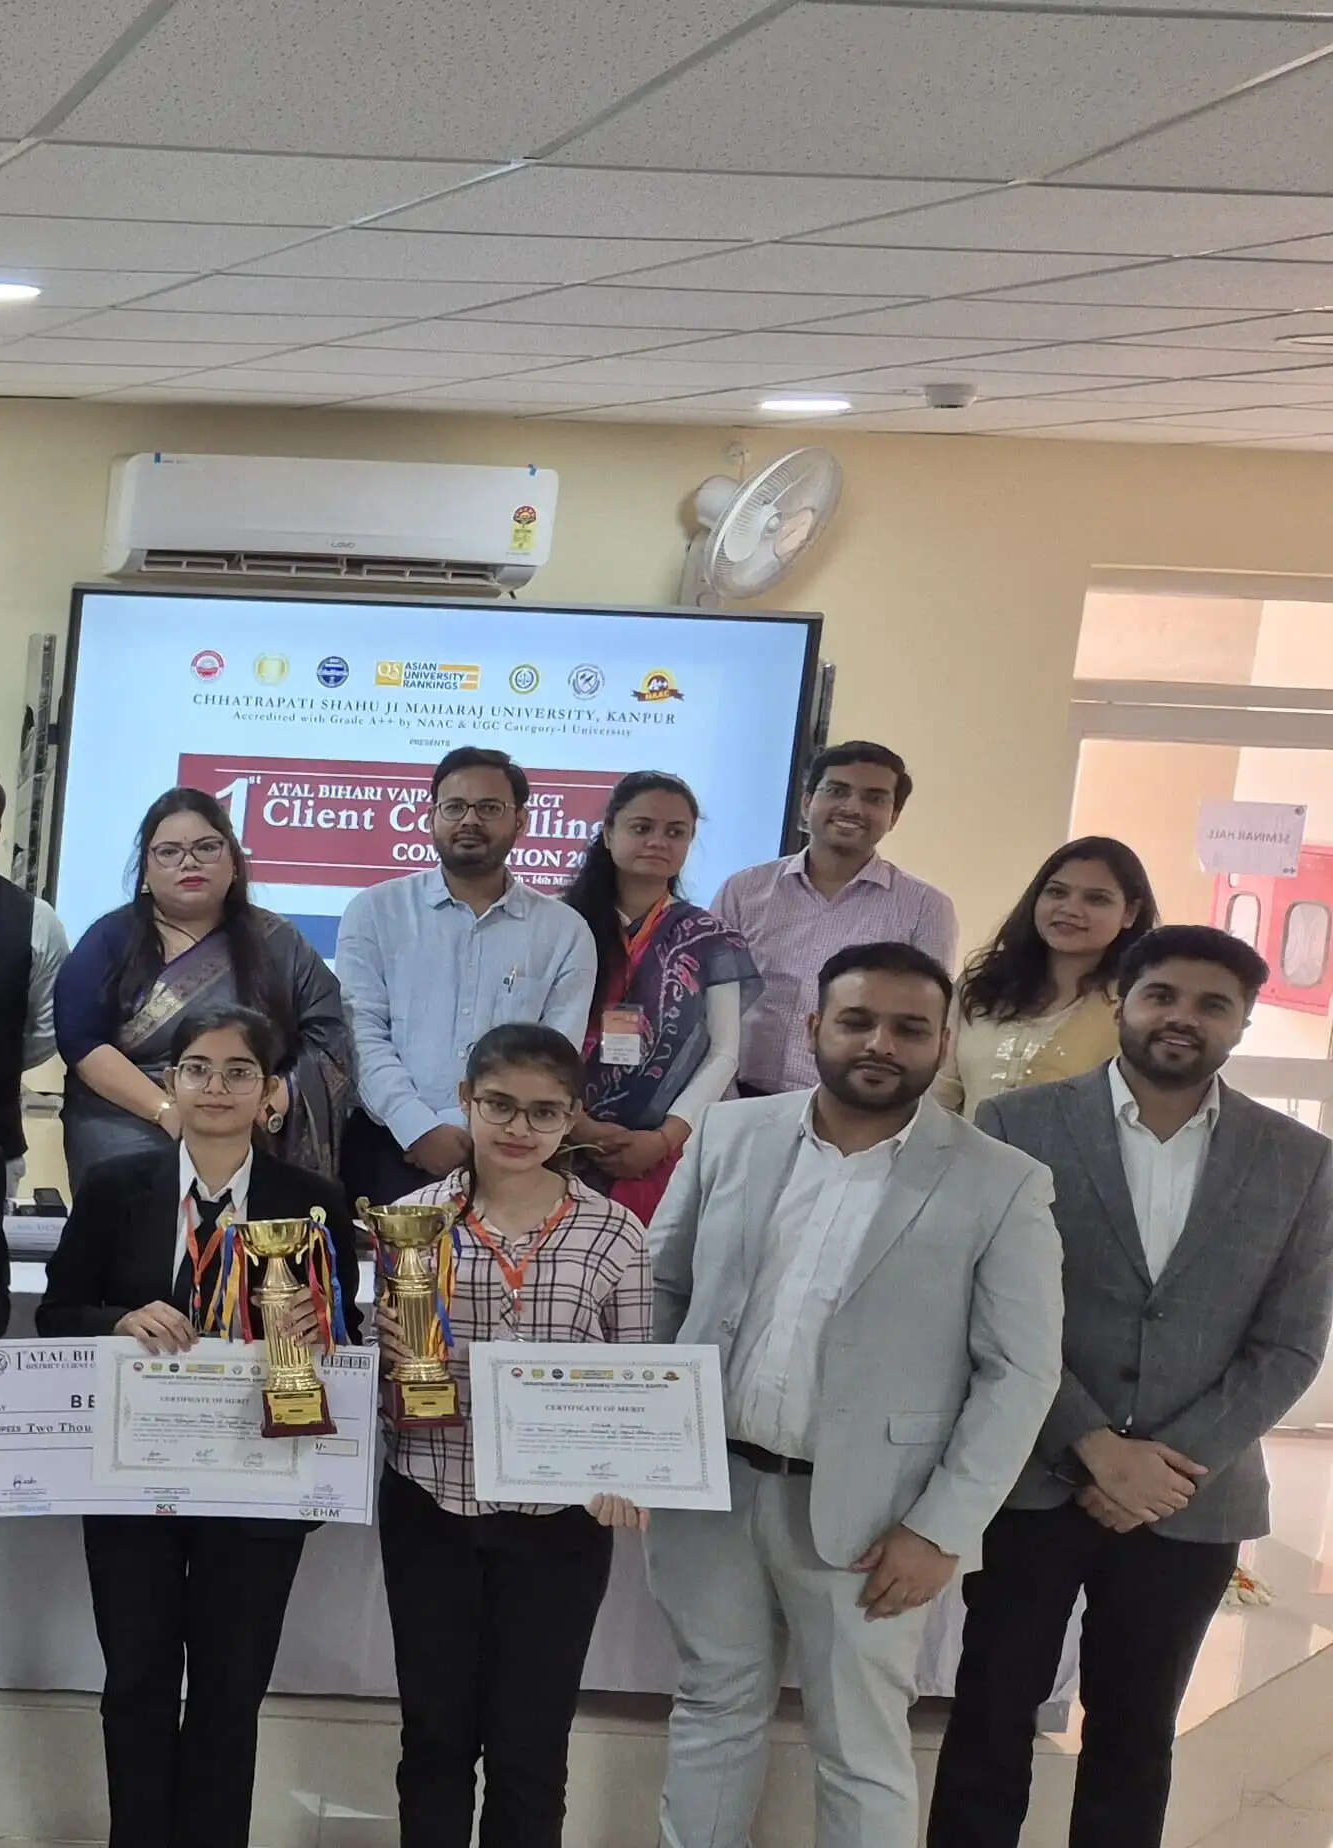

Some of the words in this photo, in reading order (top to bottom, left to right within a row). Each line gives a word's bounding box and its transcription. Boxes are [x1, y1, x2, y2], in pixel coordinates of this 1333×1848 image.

[405, 661, 437, 671] ASIAN
[404, 671, 465, 681] UNIVERSITY
[403, 680, 458, 690] RANKINGS
[192, 693, 315, 710] CHHATRAPATI
[320, 698, 380, 712] SHAHU
[385, 702, 400, 716] JI
[405, 702, 485, 720] MAHARAJ
[491, 705, 601, 723] UNIVERSITY,
[607, 710, 677, 725] KANPUR
[232, 710, 296, 723] Accredited
[300, 713, 326, 724] with
[329, 715, 364, 726] Grade
[369, 716, 394, 727] A++
[398, 717, 412, 729] by
[417, 717, 454, 730] NAAC
[457, 719, 468, 730] &
[472, 719, 501, 731] UGC
[572, 724, 633, 738] University
[267, 782, 315, 798] ATAL
[318, 784, 383, 801] BIHARI
[386, 786, 433, 804] VAJP
[262, 797, 376, 831] Client
[565, 850, 587, 868] 20
[29, 1350, 68, 1362] ATAL
[70, 1394, 95, 1409] BE
[544, 1403, 602, 1413] CERTIFICATE
[603, 1405, 615, 1413] OF
[617, 1406, 646, 1414] MERIT
[25, 1423, 54, 1433] Two
[58, 1422, 92, 1433] Thou
[313, 1507, 341, 1518] EHM
